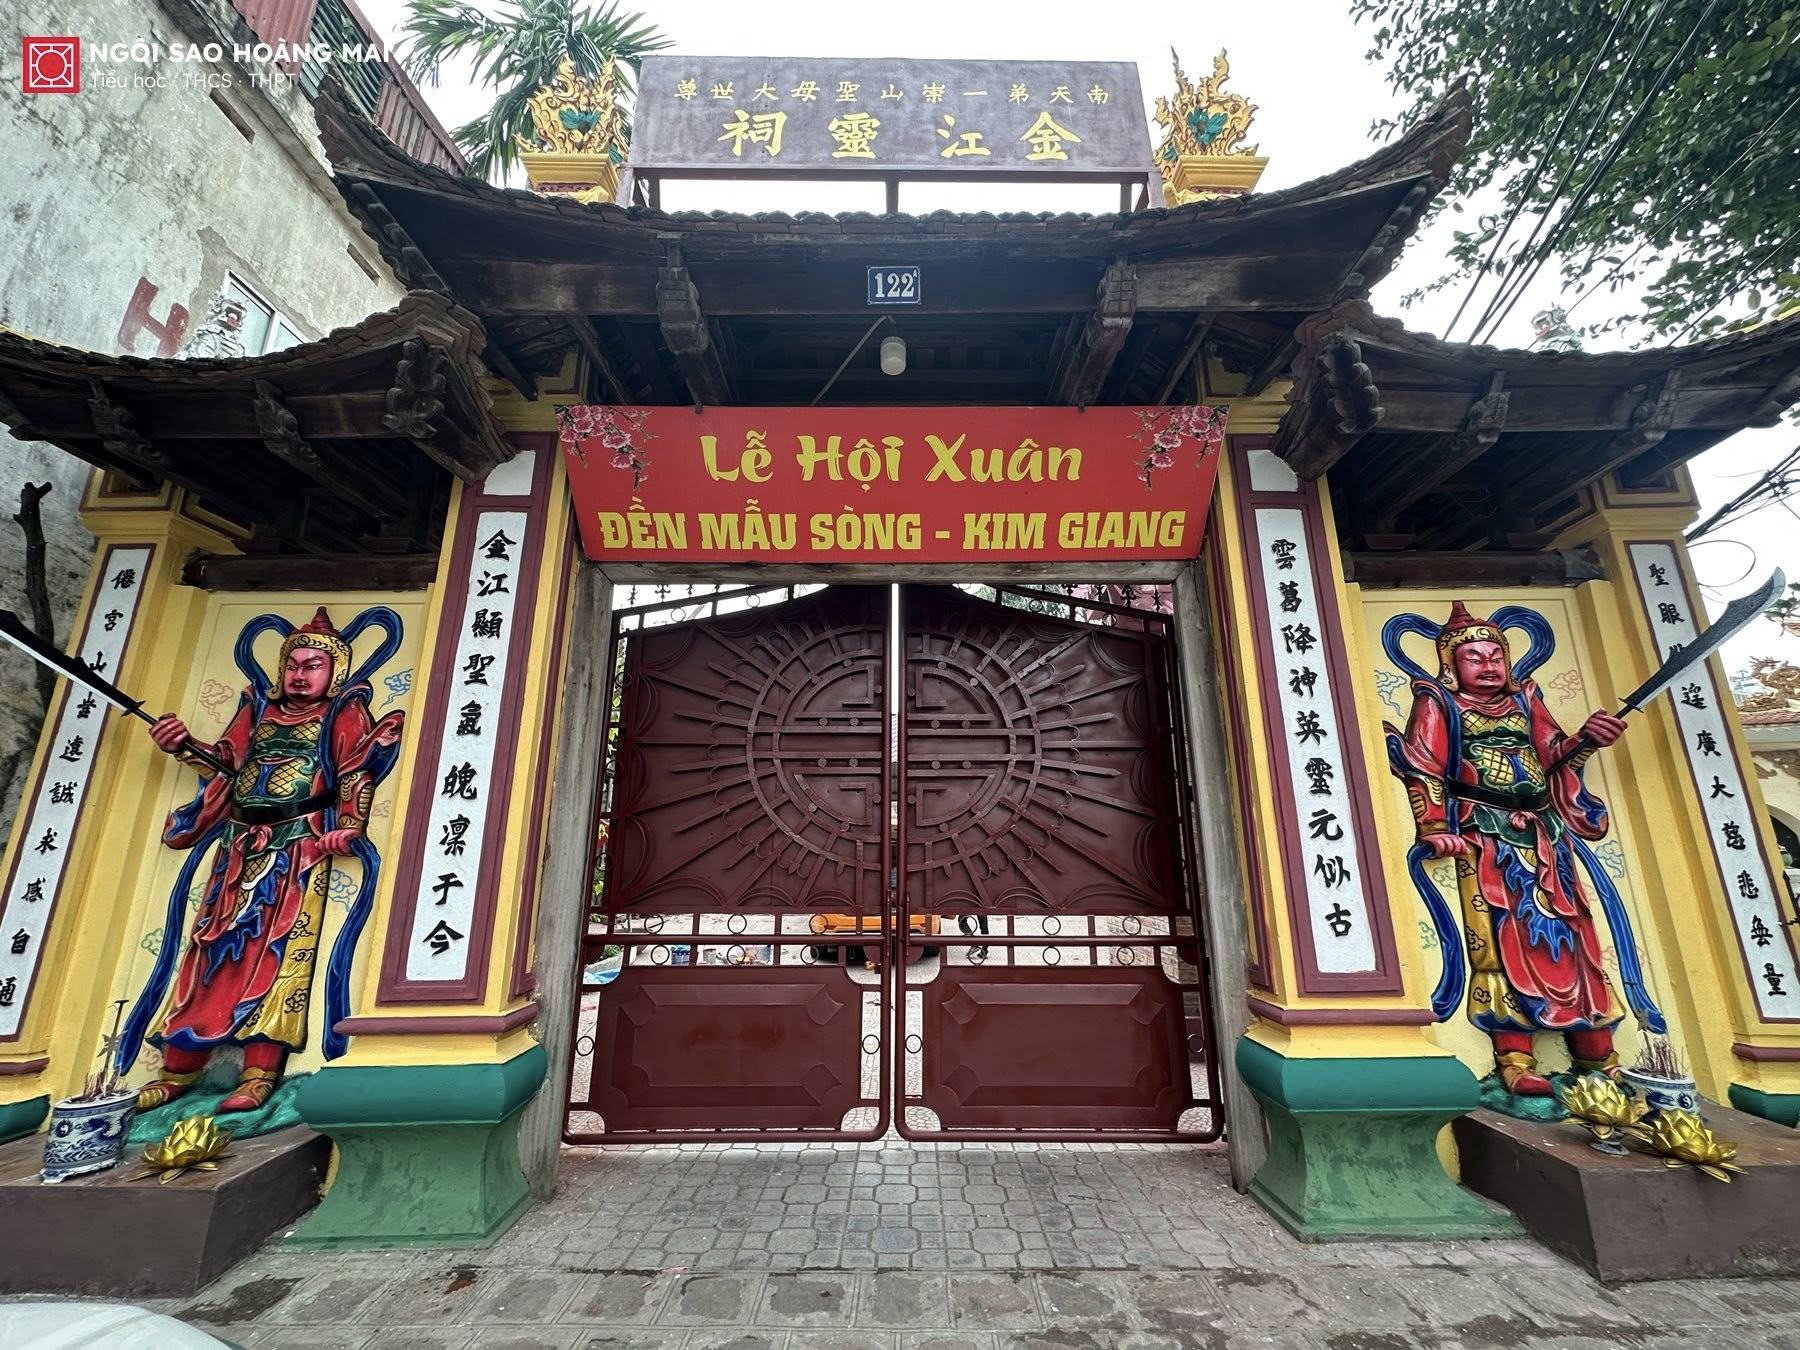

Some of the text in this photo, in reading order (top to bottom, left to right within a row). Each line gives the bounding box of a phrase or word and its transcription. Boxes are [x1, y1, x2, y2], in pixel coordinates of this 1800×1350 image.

[700, 430, 1082, 493] Lễ Hội Xuân
[597, 496, 688, 550] ĐỀN
[698, 498, 797, 550] MẪU
[809, 505, 922, 550] SÒNG
[962, 512, 1047, 550] KIM
[1058, 510, 1187, 549] GIANG
